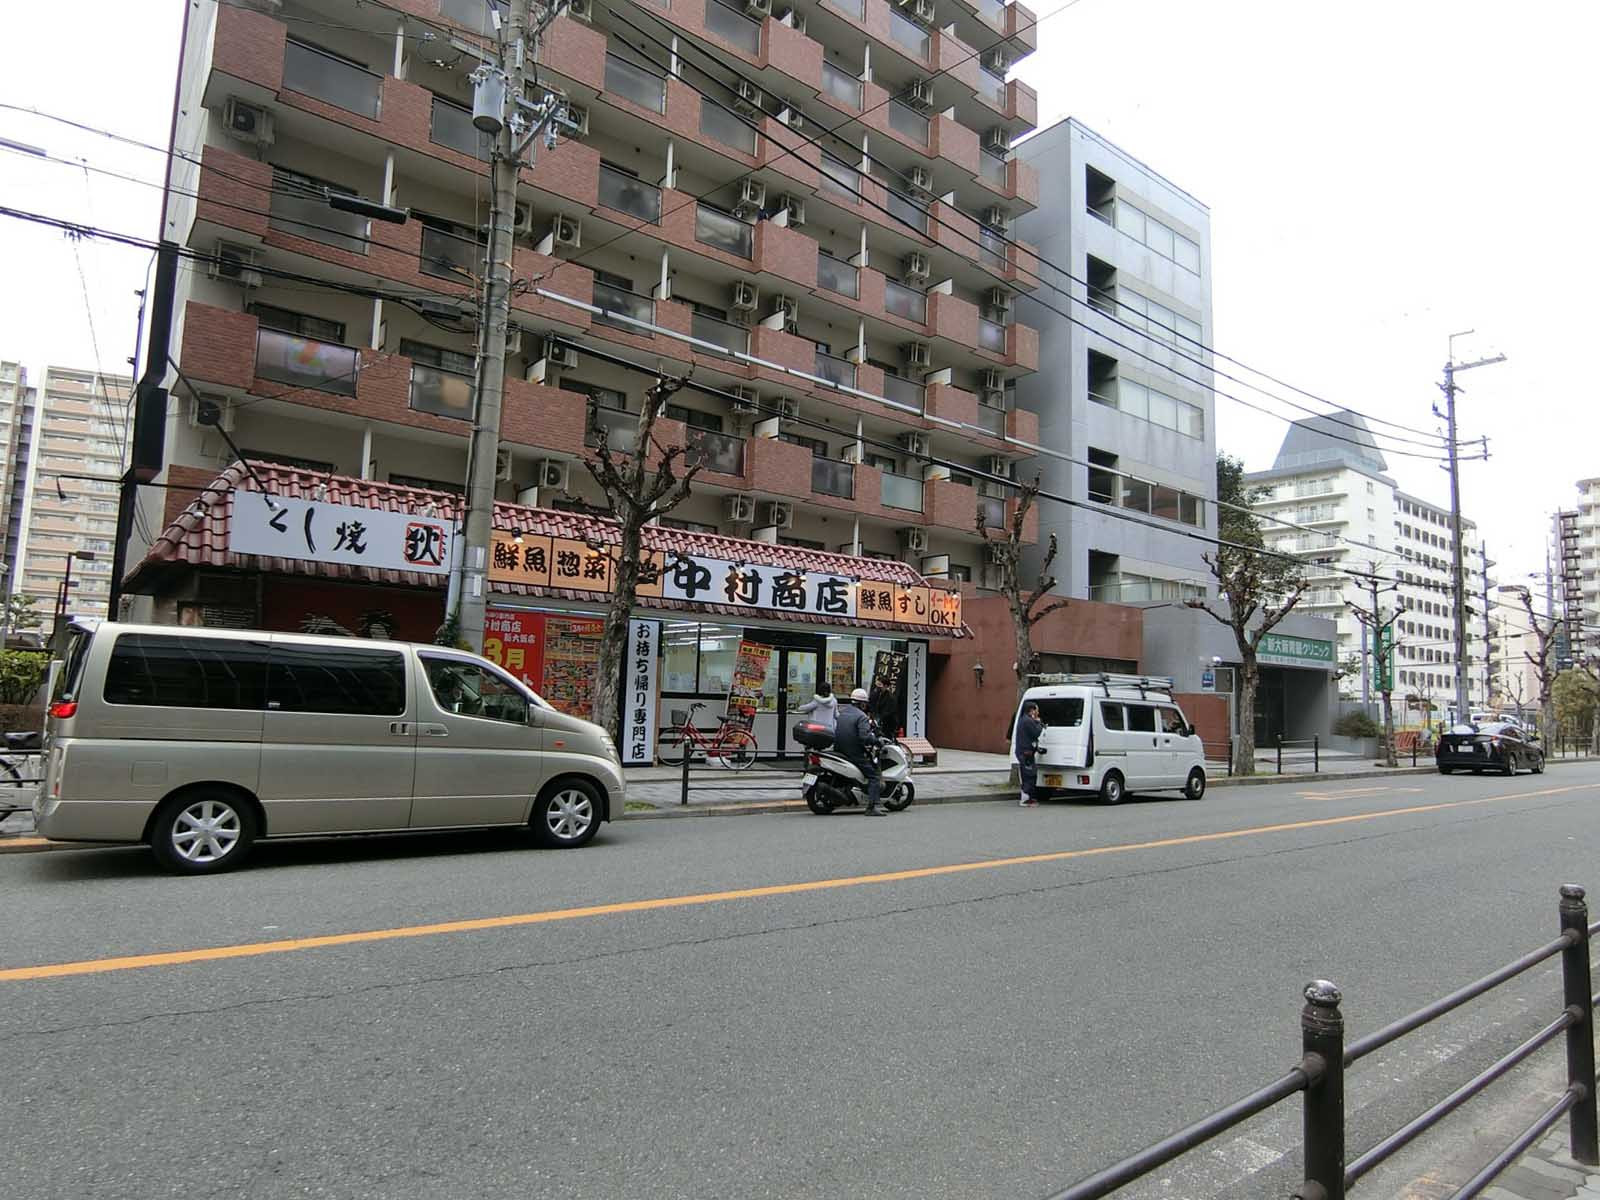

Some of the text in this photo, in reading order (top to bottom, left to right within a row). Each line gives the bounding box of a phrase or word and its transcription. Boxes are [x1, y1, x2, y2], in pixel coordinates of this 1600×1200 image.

[269, 507, 368, 555] くし焼
[493, 542, 548, 574] 鮮魚
[557, 550, 606, 580] 惣菜
[672, 558, 849, 614] 中村商店
[860, 589, 893, 612] 鮮魚
[897, 595, 926, 616] すし
[931, 609, 956, 626] OK!
[485, 637, 526, 670] 3月
[631, 623, 651, 760] お持ち帰り専門店
